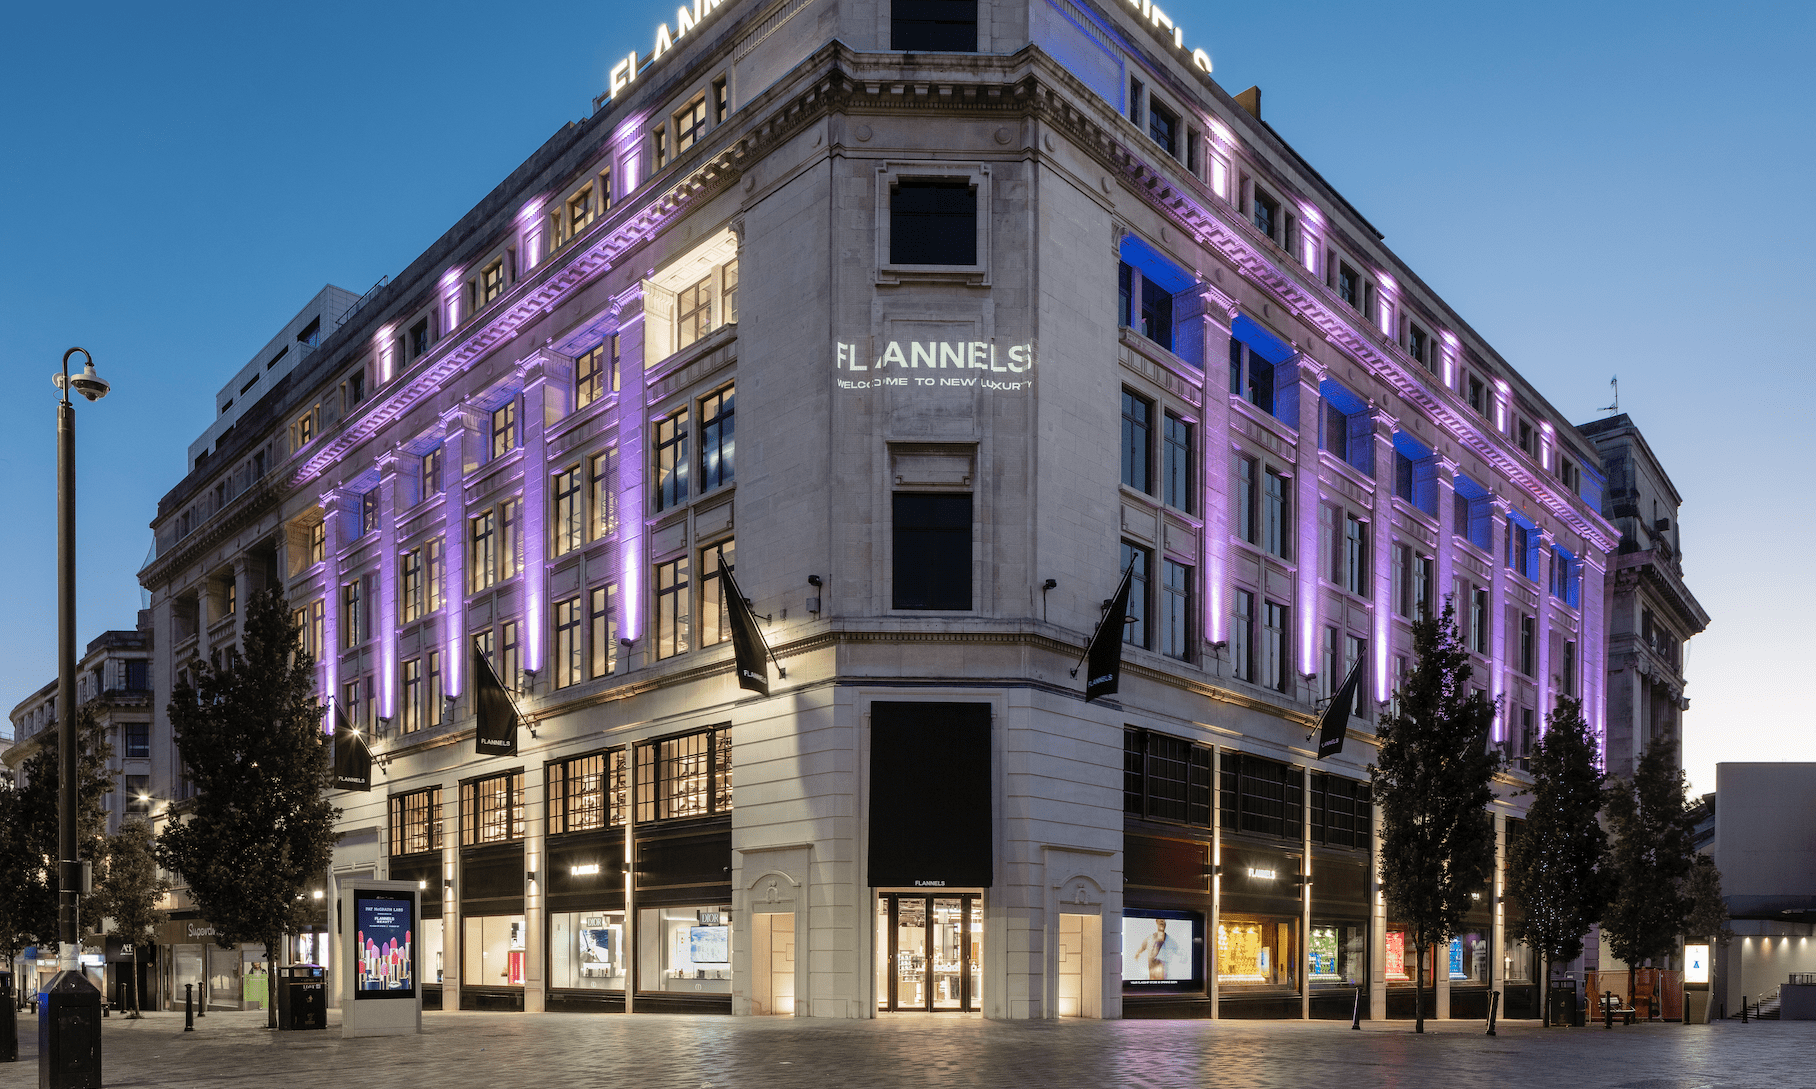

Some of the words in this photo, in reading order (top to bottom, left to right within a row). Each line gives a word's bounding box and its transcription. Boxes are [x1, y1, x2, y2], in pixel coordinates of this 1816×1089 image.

[837, 341, 1032, 373] FLANNELS
[837, 377, 908, 389] WELCOME
[914, 377, 936, 386] TO
[939, 377, 976, 386] NEW
[980, 378, 1032, 391] LUXURY
[480, 737, 511, 746] FLANNELS
[337, 775, 365, 784] FLANNELS
[914, 879, 946, 887] FLANNELS
[587, 917, 603, 927] DIOR
[701, 913, 719, 923] DIOR
